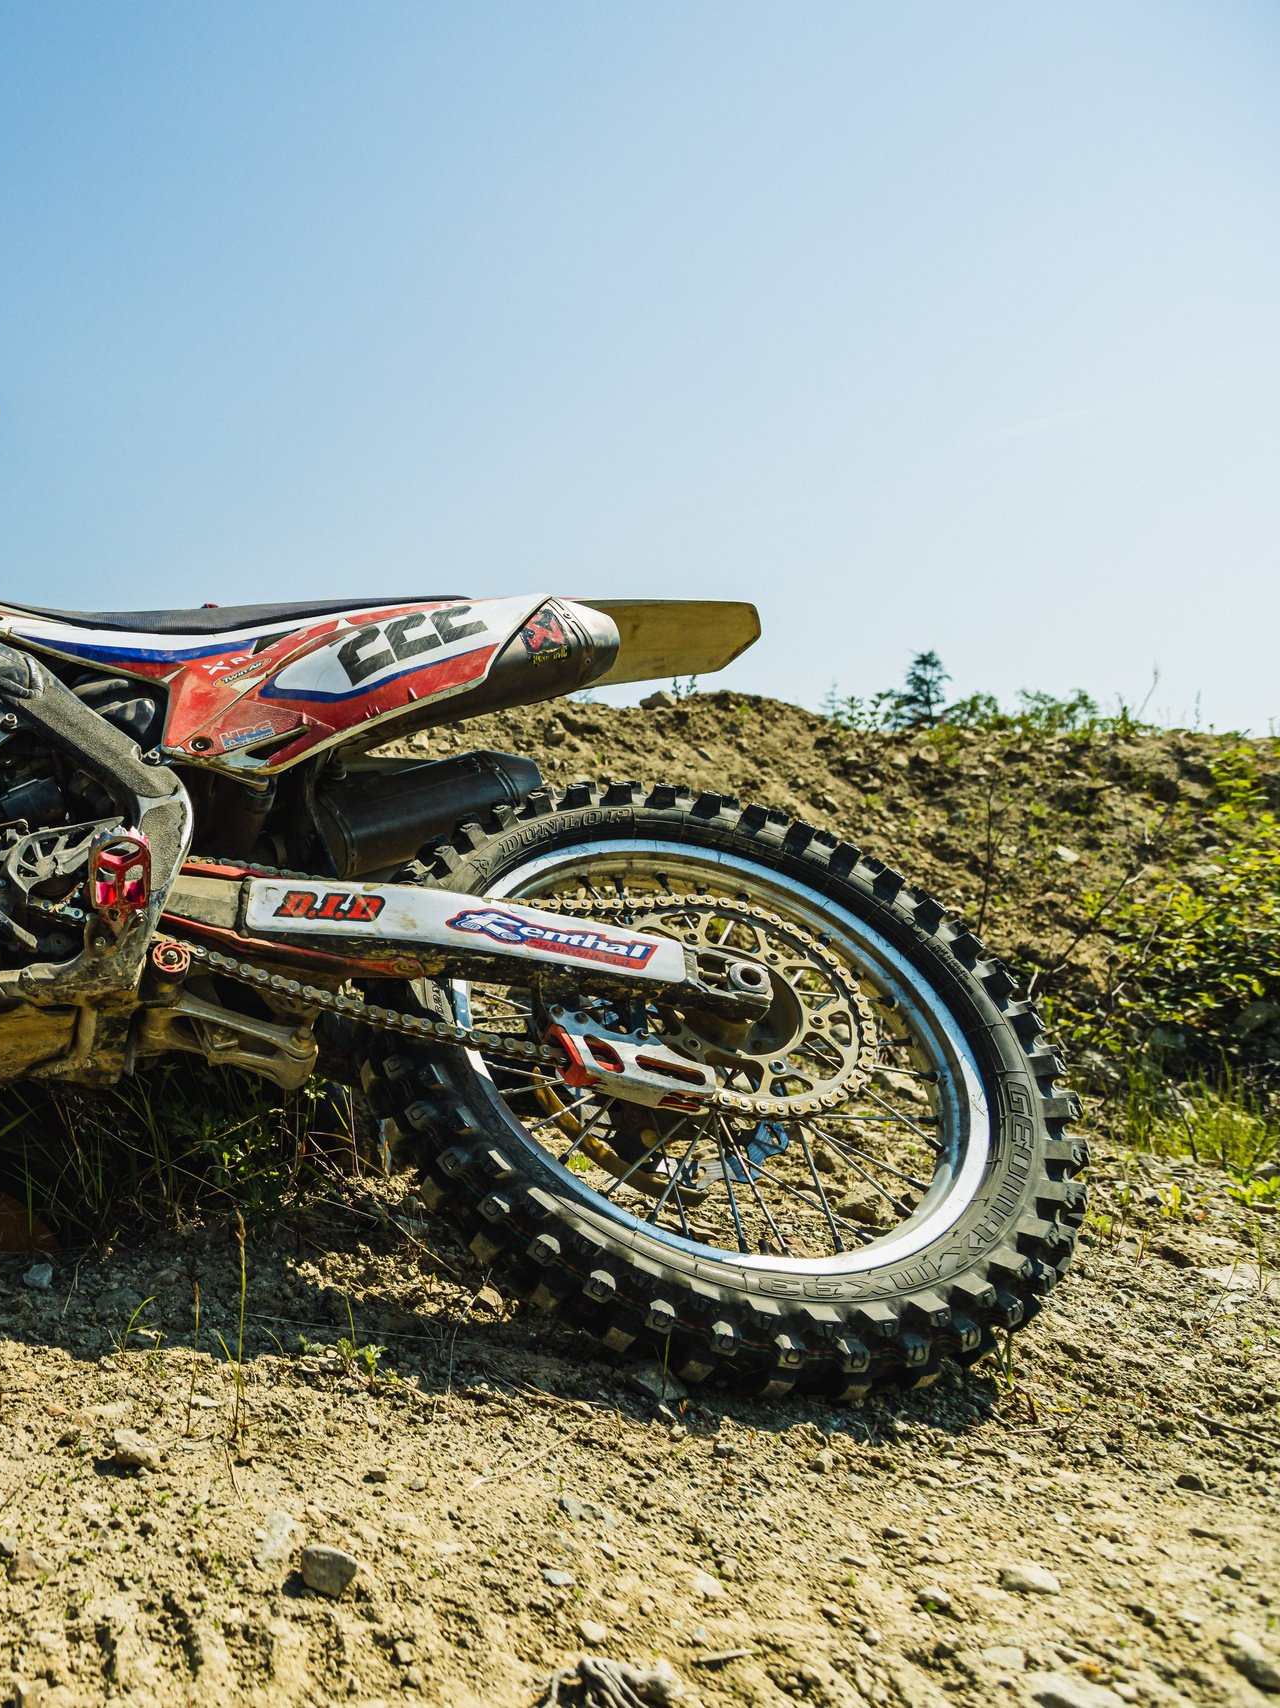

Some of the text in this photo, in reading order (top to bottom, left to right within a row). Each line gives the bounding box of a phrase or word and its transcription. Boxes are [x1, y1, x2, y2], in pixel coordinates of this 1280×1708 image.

[220, 720, 275, 747] HRC
[498, 807, 633, 858] DUNLOP
[453, 912, 652, 958] Renthal
[527, 939, 631, 967] CHAINWHEELS
[758, 1080, 1035, 1299] GEOMAX MX33
